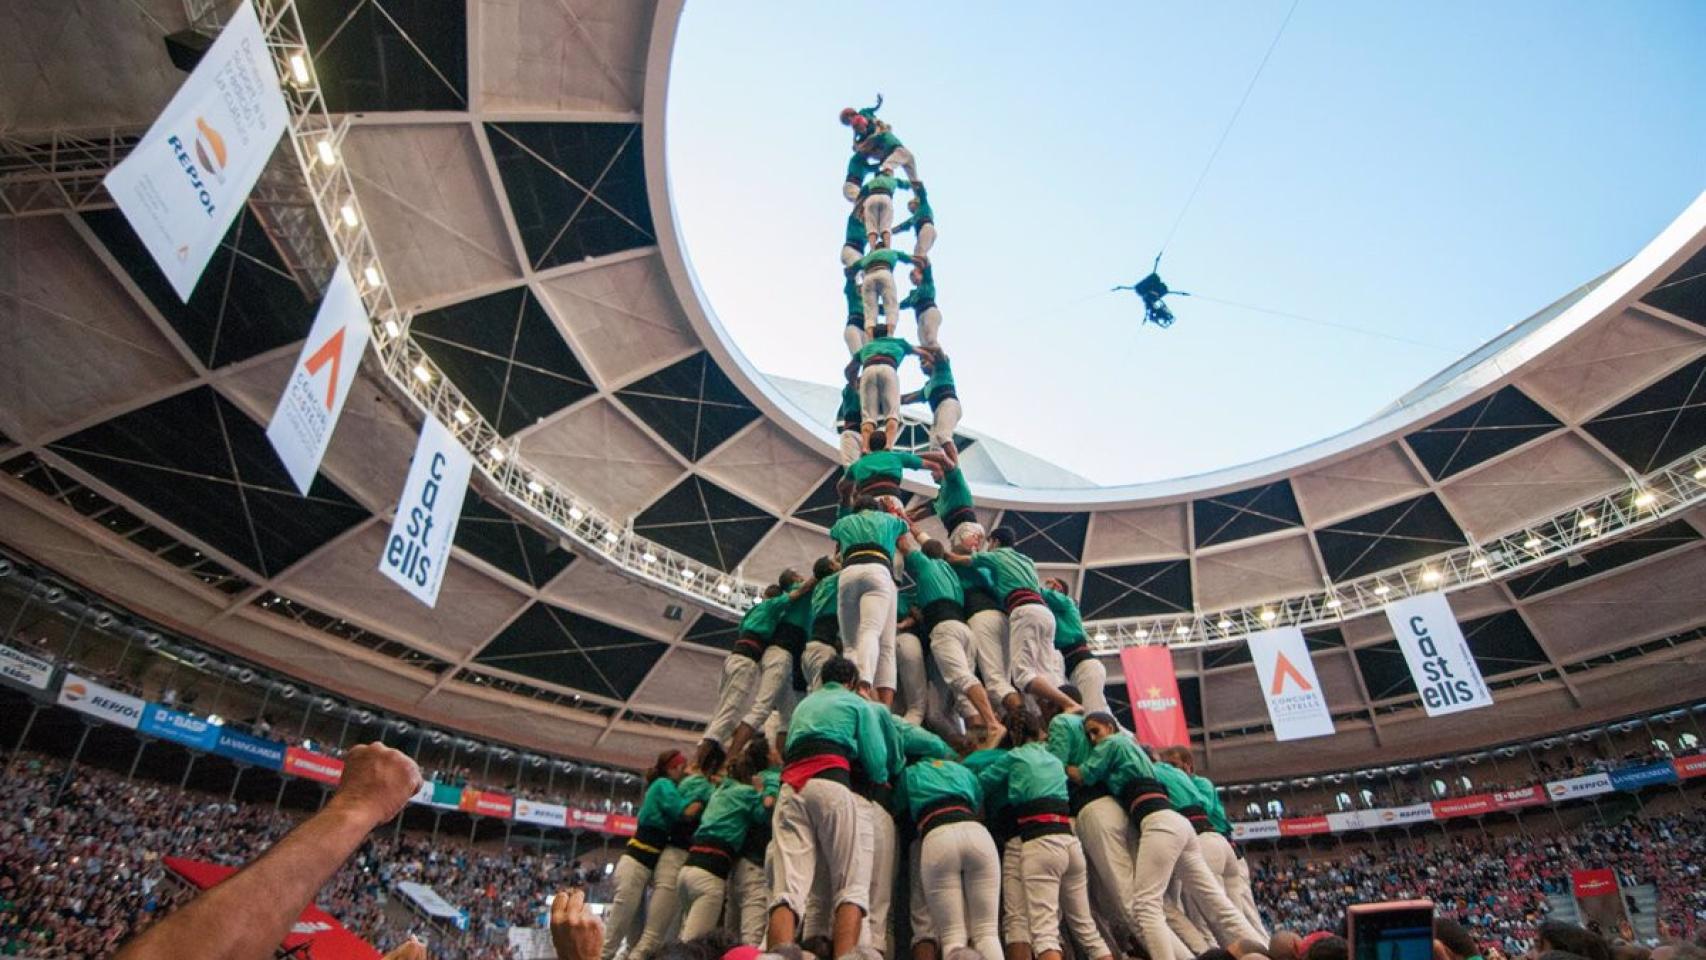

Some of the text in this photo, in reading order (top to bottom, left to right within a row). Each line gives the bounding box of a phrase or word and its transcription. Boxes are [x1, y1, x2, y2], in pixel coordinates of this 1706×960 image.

[167, 134, 216, 217] REPSOL
[91, 696, 140, 718] REPSOL
[1572, 780, 1609, 791] REPSOL
